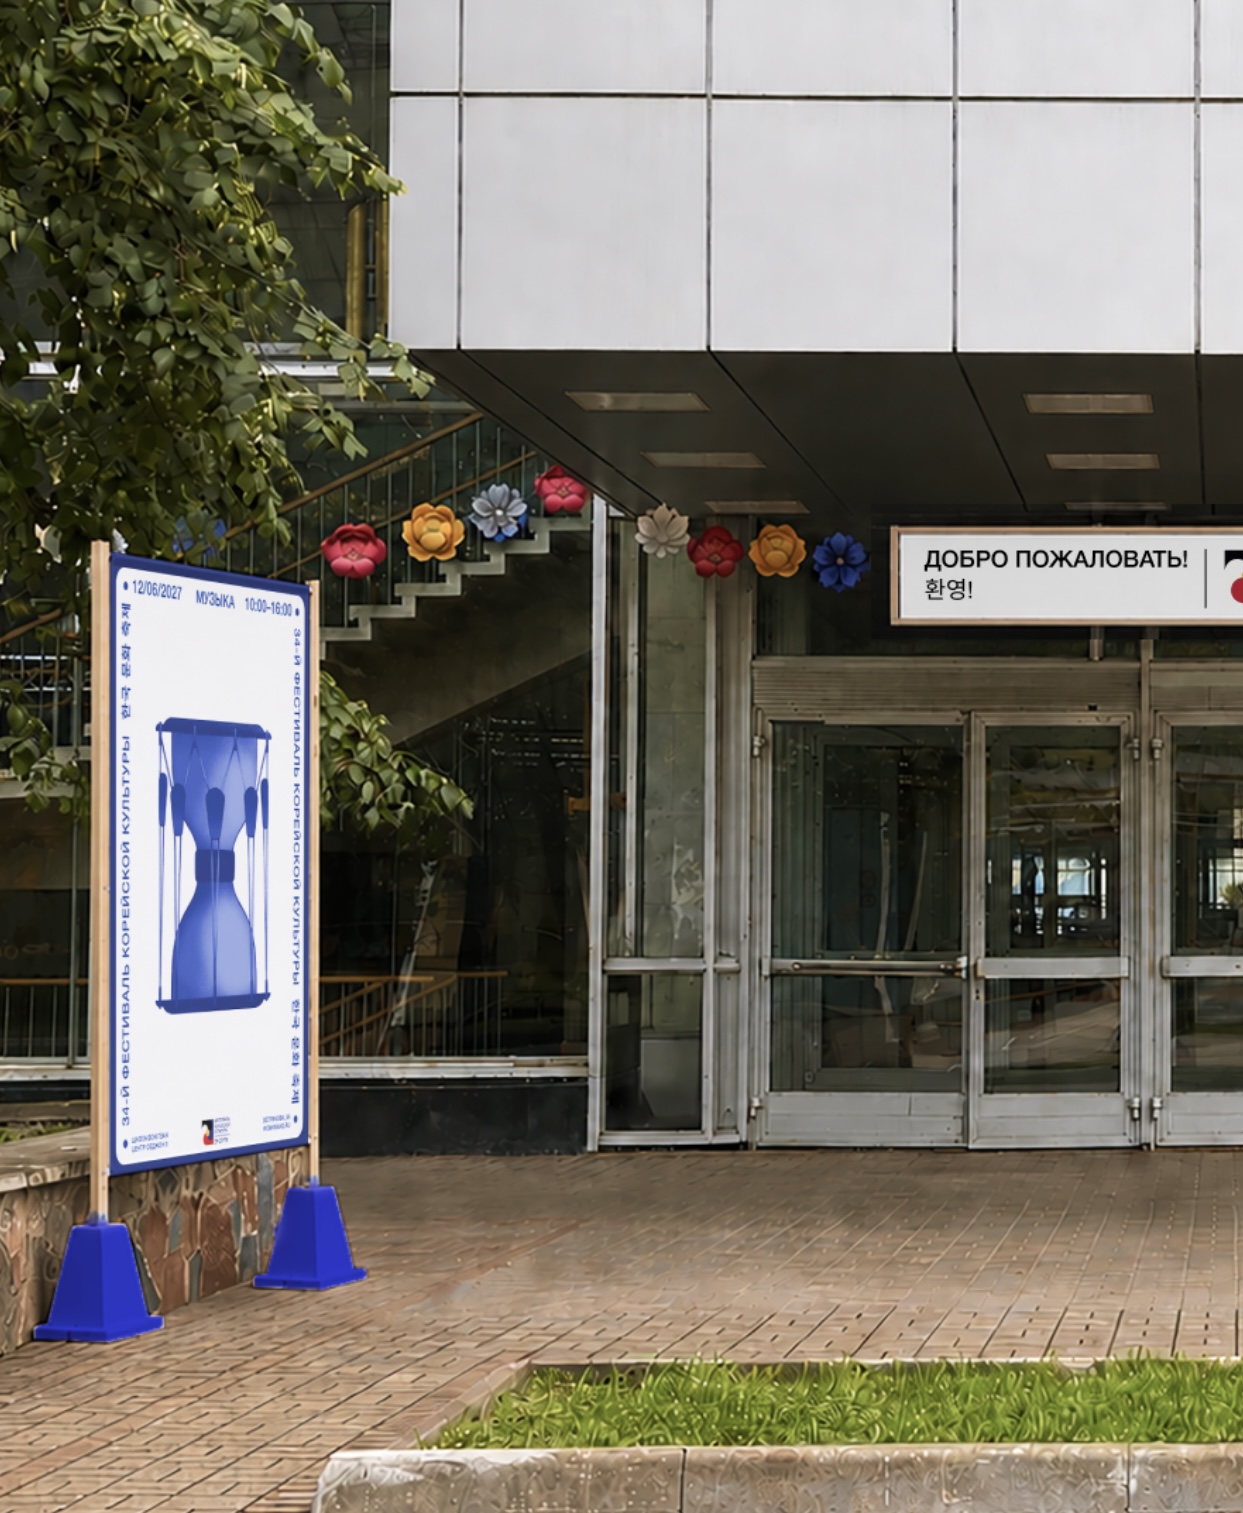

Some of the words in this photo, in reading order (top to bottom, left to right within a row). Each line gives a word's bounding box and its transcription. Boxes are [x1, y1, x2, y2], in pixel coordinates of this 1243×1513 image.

[132, 579, 183, 600] 12/06/2027
[196, 590, 236, 609] МУЗЫКА
[924, 549, 1008, 571] ДОБРО
[1015, 549, 1188, 569] ПОЖАЛОВАТЬ!
[924, 578, 973, 601] 환영!
[121, 686, 132, 720] 한국
[293, 672, 301, 778] ФЕСТИВАЛЬ
[121, 736, 130, 836] КУЛЬТУРЫ
[292, 783, 302, 891] КОРЕЙСКОЙ
[120, 841, 130, 959] КОРЕЙСКОЙ
[292, 896, 301, 986] КУЛЬТУРЫ
[121, 964, 130, 1080] ФЕСТИВАЛЬ
[120, 1086, 130, 1127] 34-Й
